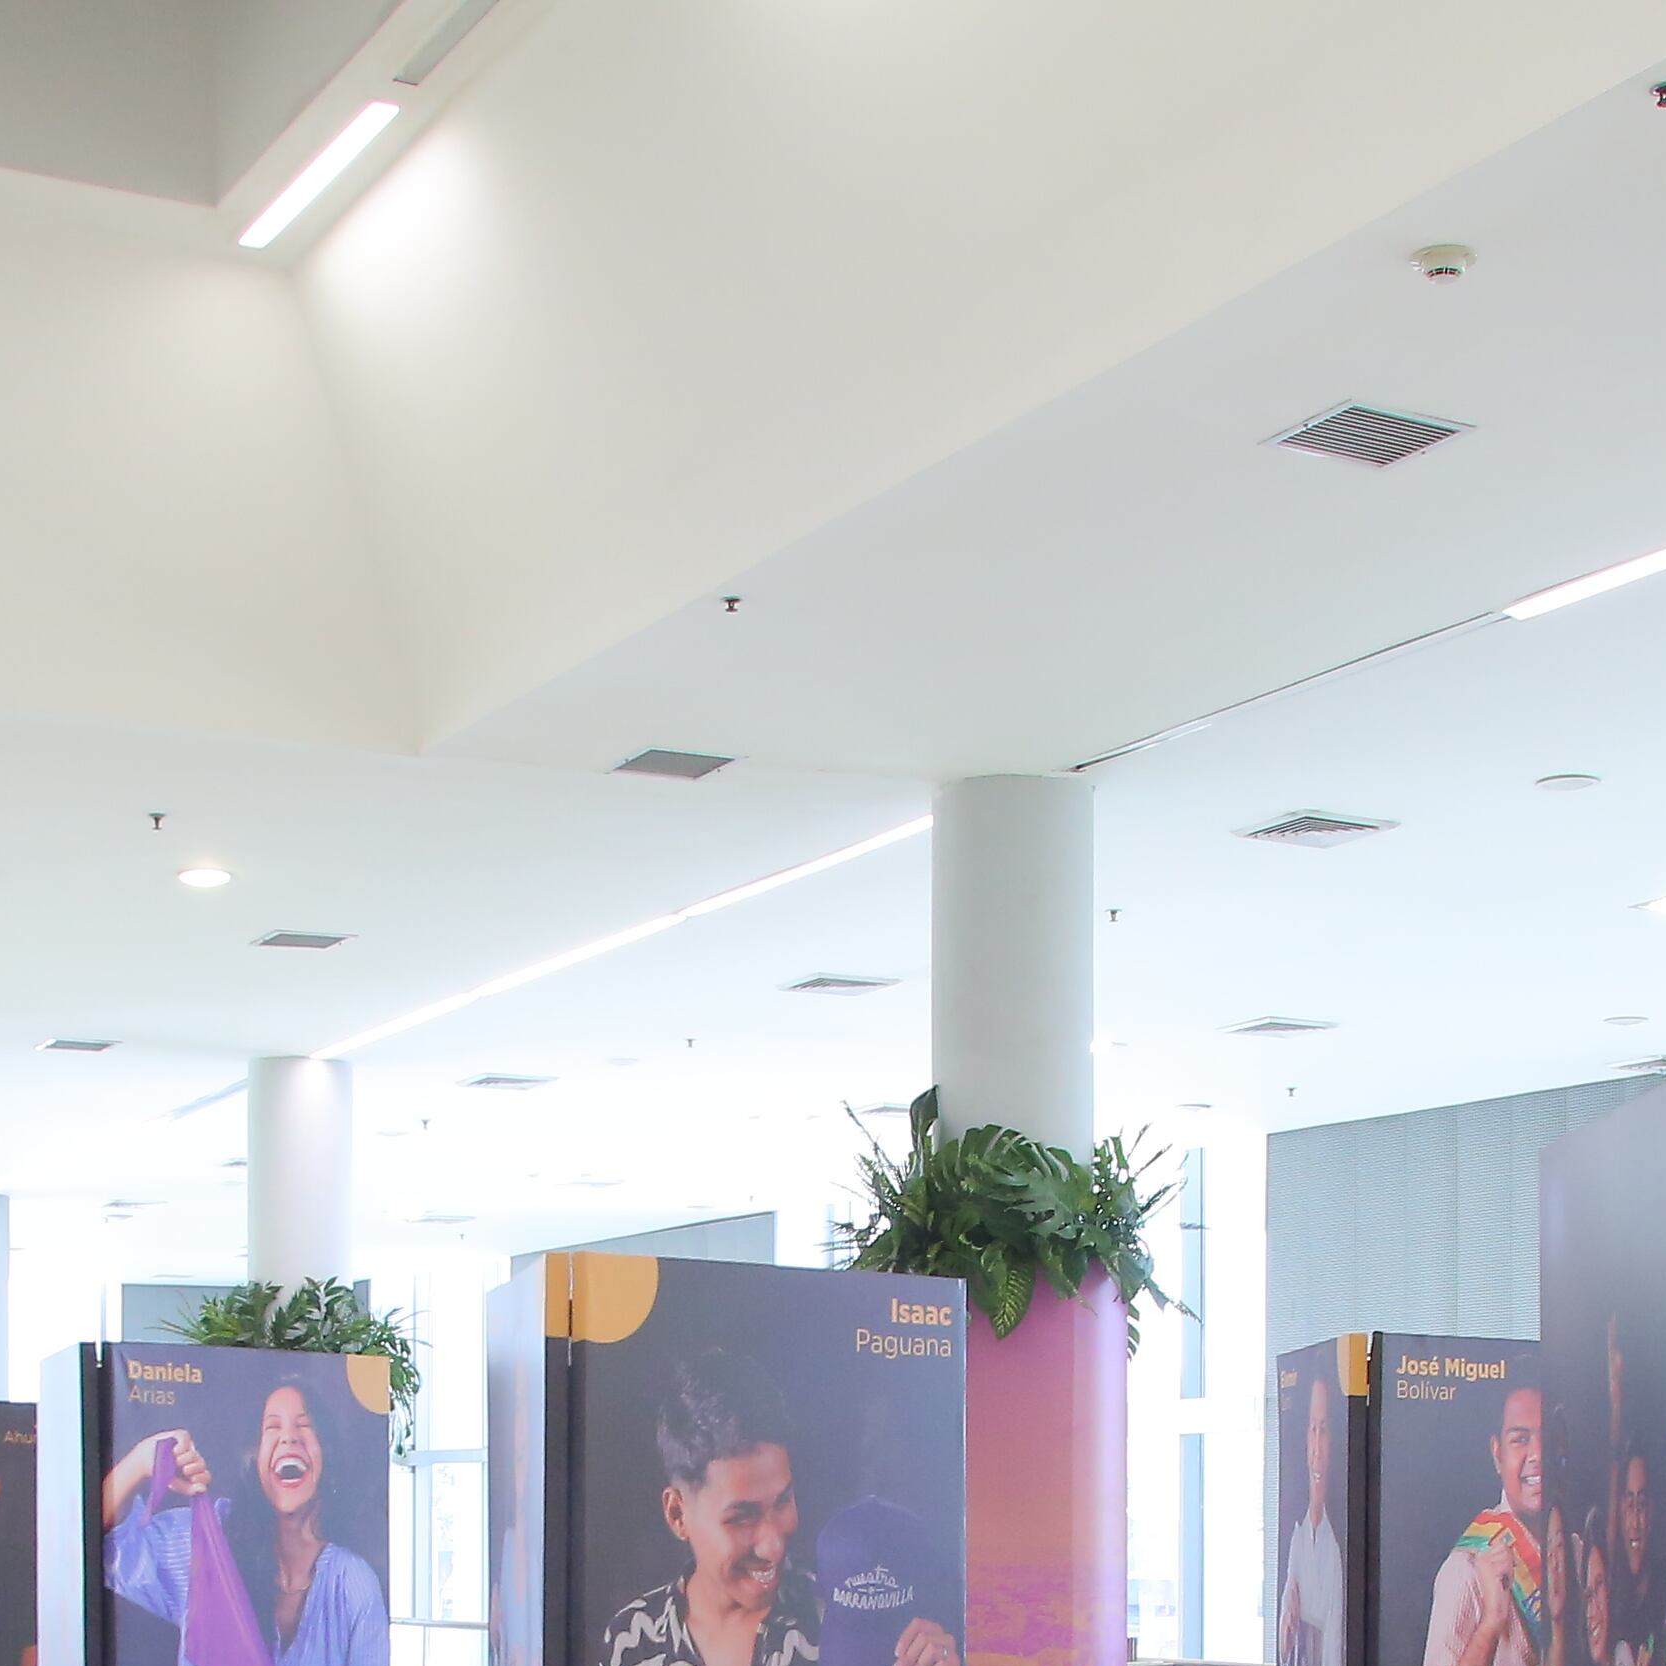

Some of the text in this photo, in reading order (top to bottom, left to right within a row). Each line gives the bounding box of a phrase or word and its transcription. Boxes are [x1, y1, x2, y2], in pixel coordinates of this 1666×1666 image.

[891, 1300, 953, 1325] Isaac
[856, 1328, 954, 1358] Paguana
[127, 1360, 203, 1383] Daniela
[1397, 1355, 1508, 1381] José Miguel
[128, 1384, 176, 1403] Arias
[1396, 1379, 1456, 1400] Bolívar
[844, 1564, 899, 1589] nuestra
[833, 1586, 914, 1611] BARRANQUILLA
